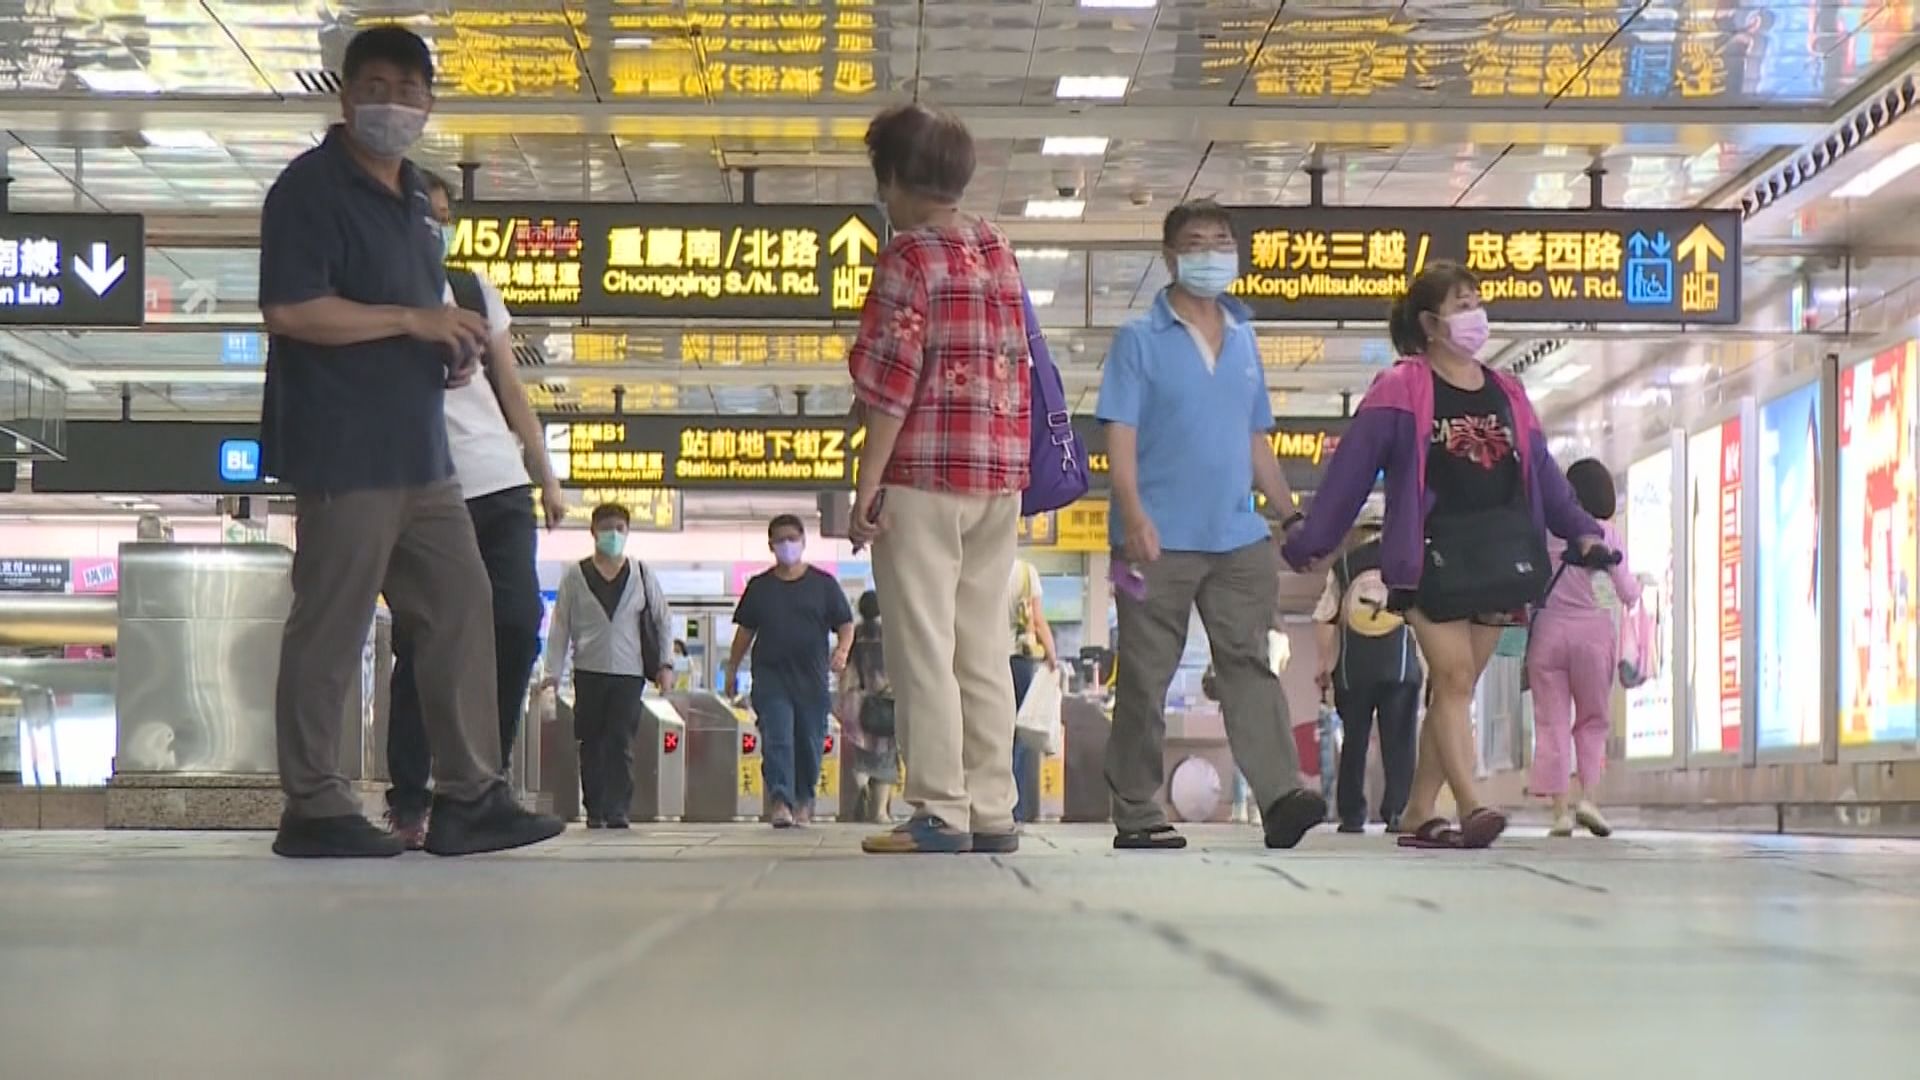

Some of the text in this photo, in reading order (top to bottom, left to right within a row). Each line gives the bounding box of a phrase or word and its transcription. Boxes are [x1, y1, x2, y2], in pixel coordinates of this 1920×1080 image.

[1467, 231, 1622, 272] 忠孝西路
[18, 281, 60, 304] Line
[503, 287, 581, 303] Airport MRT
[603, 270, 722, 297] Chongqing
[782, 270, 820, 294] Rd.
[1478, 276, 1623, 300] gxiao W. Rd.
[226, 450, 255, 470] BL
[676, 459, 727, 478] Station
[730, 459, 766, 477] Front
[769, 460, 811, 477] Metro
[814, 460, 845, 478] Mall
